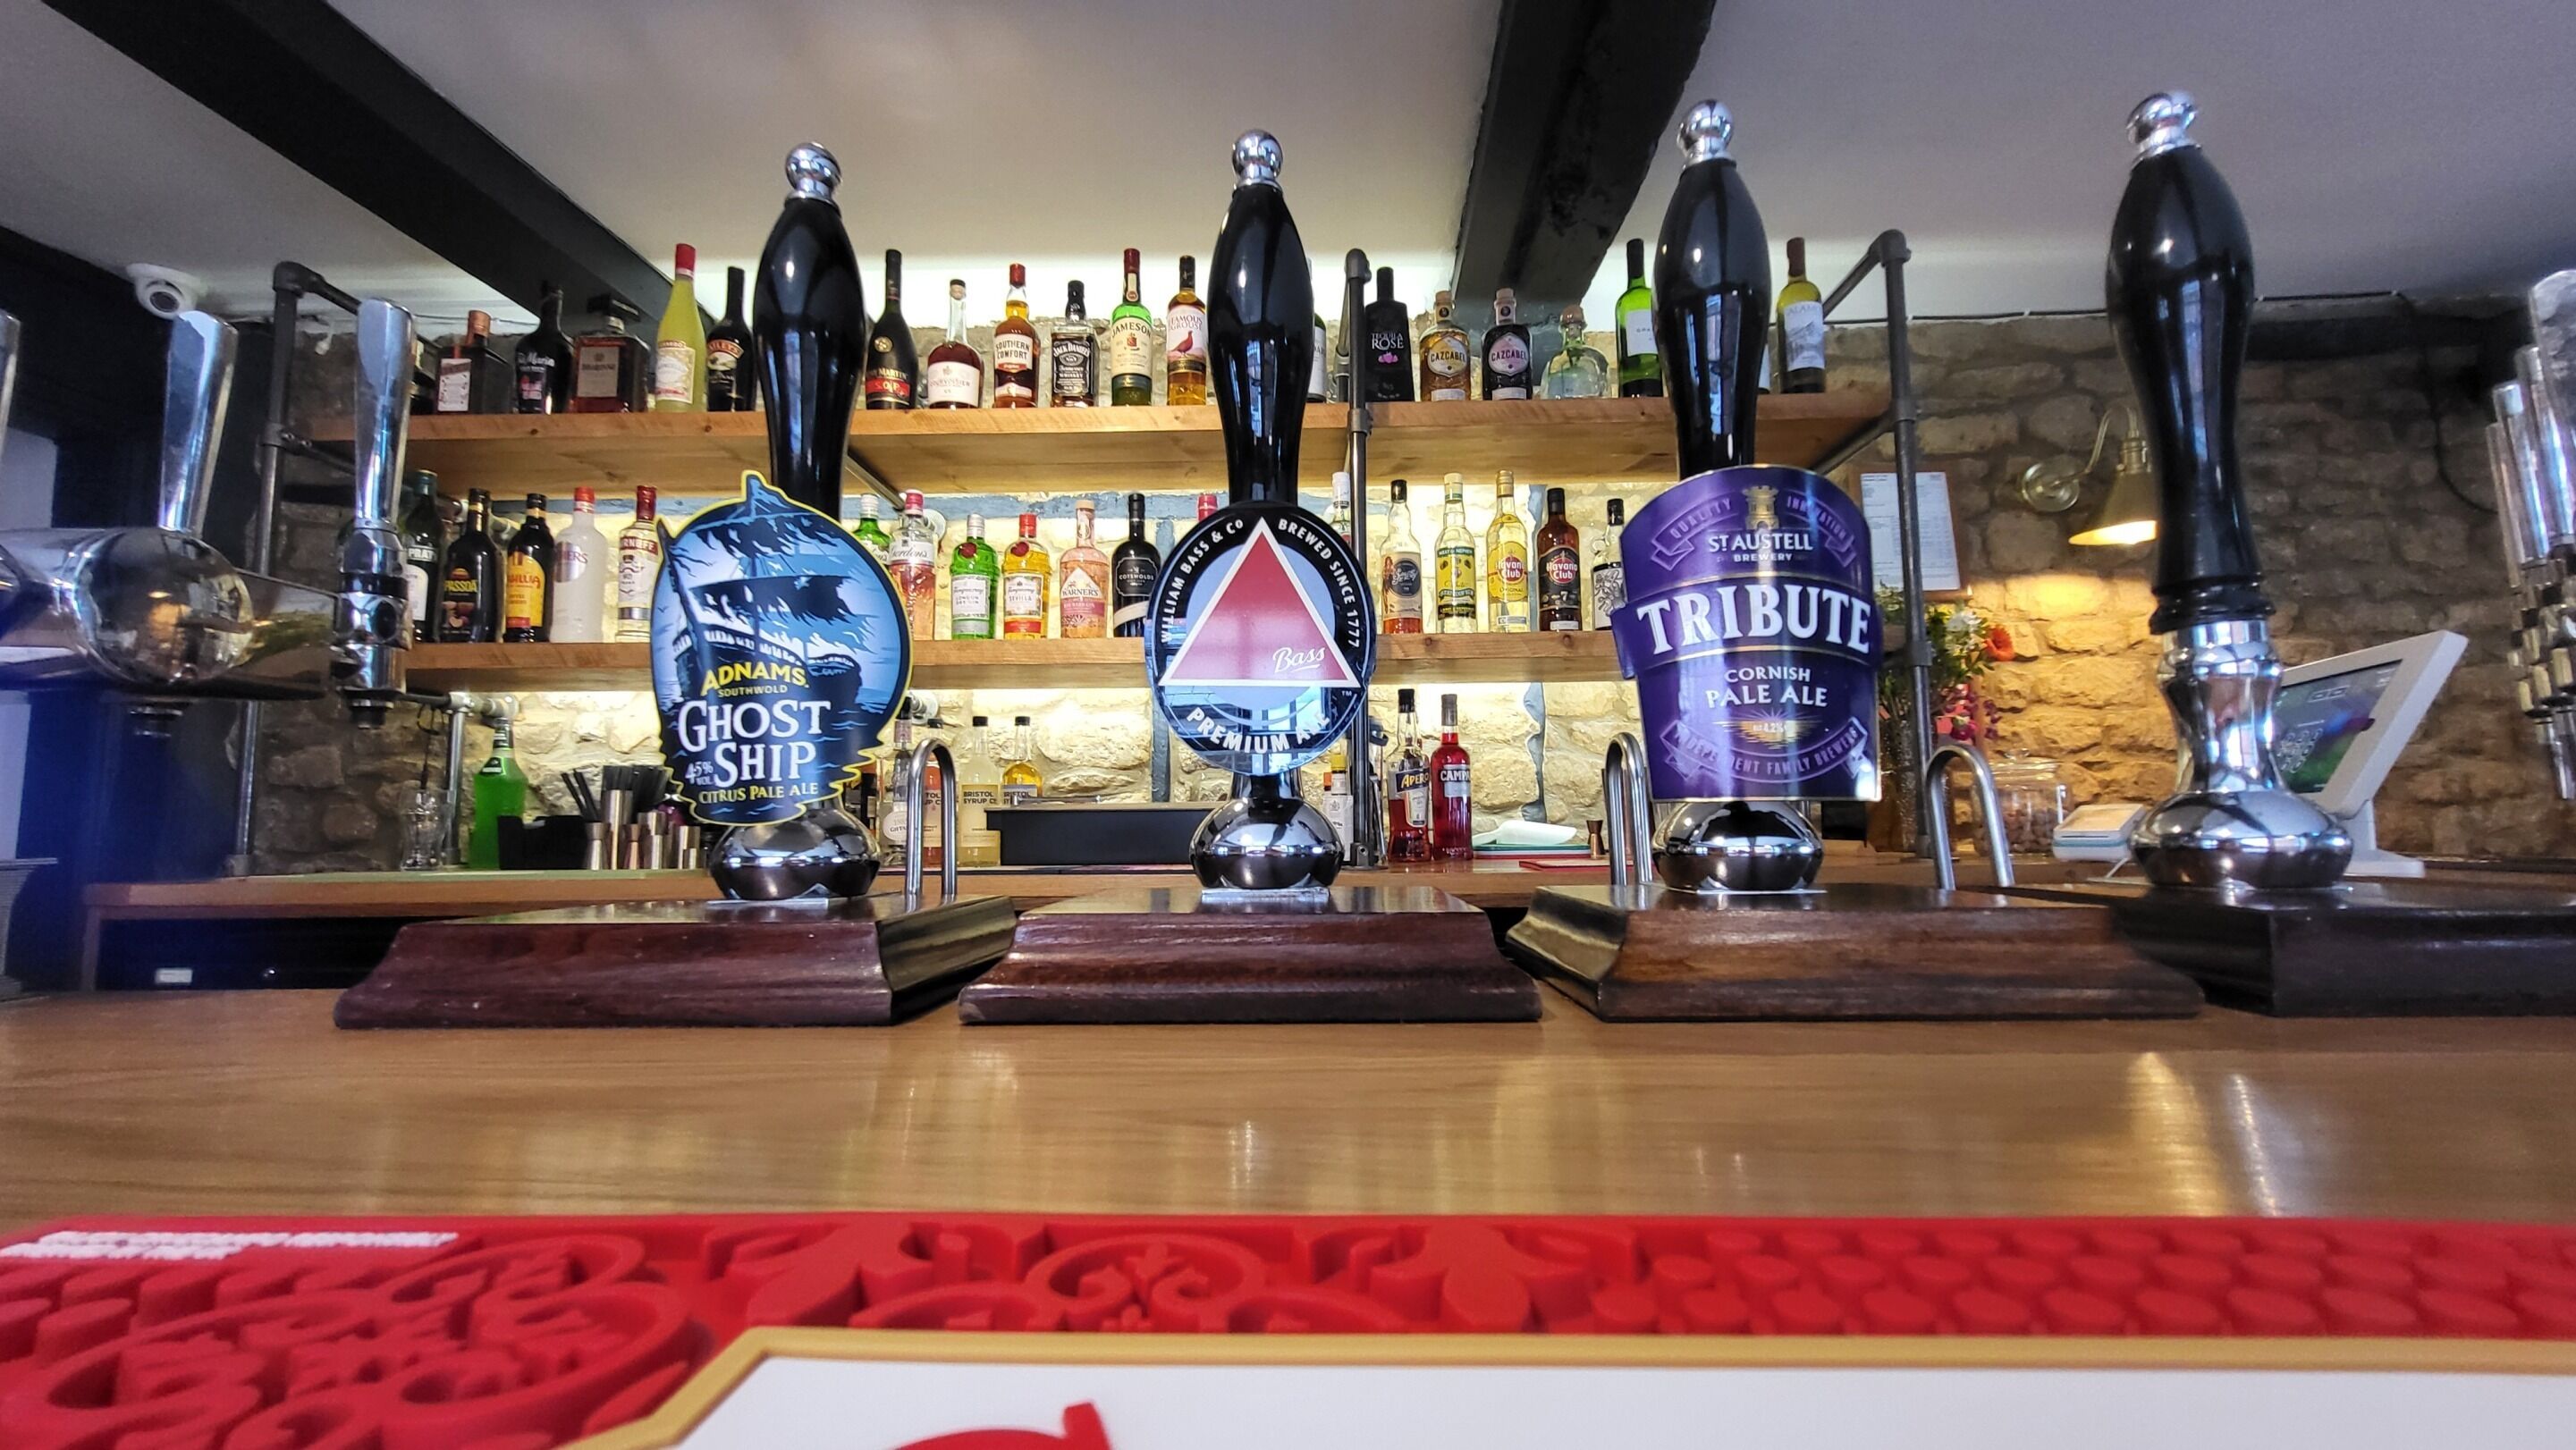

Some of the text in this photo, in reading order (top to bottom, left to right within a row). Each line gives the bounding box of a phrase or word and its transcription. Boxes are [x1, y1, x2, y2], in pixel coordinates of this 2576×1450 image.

[1170, 322, 1203, 331] GROUSE
[1171, 315, 1204, 325] FAMOUS
[1111, 322, 1152, 339] JAMESON
[1371, 332, 1404, 341] TEQUILA
[996, 340, 1030, 352] SOUTHERN
[1053, 344, 1068, 358] JACK
[1372, 337, 1405, 351] ROSE
[997, 350, 1027, 360] COMFORT
[1431, 350, 1466, 363] CAZCABEL
[1669, 498, 1731, 539] QUALITY
[1731, 533, 1814, 552] AUSTELL
[1733, 552, 1794, 562] BREWERY
[1501, 567, 1521, 579] Club
[1546, 561, 1578, 571] Havana
[1119, 573, 1154, 581] COTSWOLDS
[1553, 569, 1574, 579] Club
[1161, 577, 1186, 643] WILLIAM
[1180, 540, 1209, 574] BASS
[1212, 530, 1224, 543] &
[1278, 518, 1360, 648] BREWED SINCE 1777
[1560, 590, 1568, 602] 7
[1637, 584, 1871, 655] TRIBUTE
[1272, 647, 1326, 673] Bass
[700, 662, 807, 695] ADNAMS
[1724, 666, 1812, 683] CORNISH
[718, 685, 788, 698] SOUTHWOLD
[1705, 686, 1829, 708] PALE ALE
[678, 700, 832, 753] GHOST
[1187, 706, 1290, 754] PREMIUM
[714, 741, 817, 788] SHIP
[1401, 772, 1429, 788] APERO
[698, 782, 819, 804] CITRUS PALE ALE
